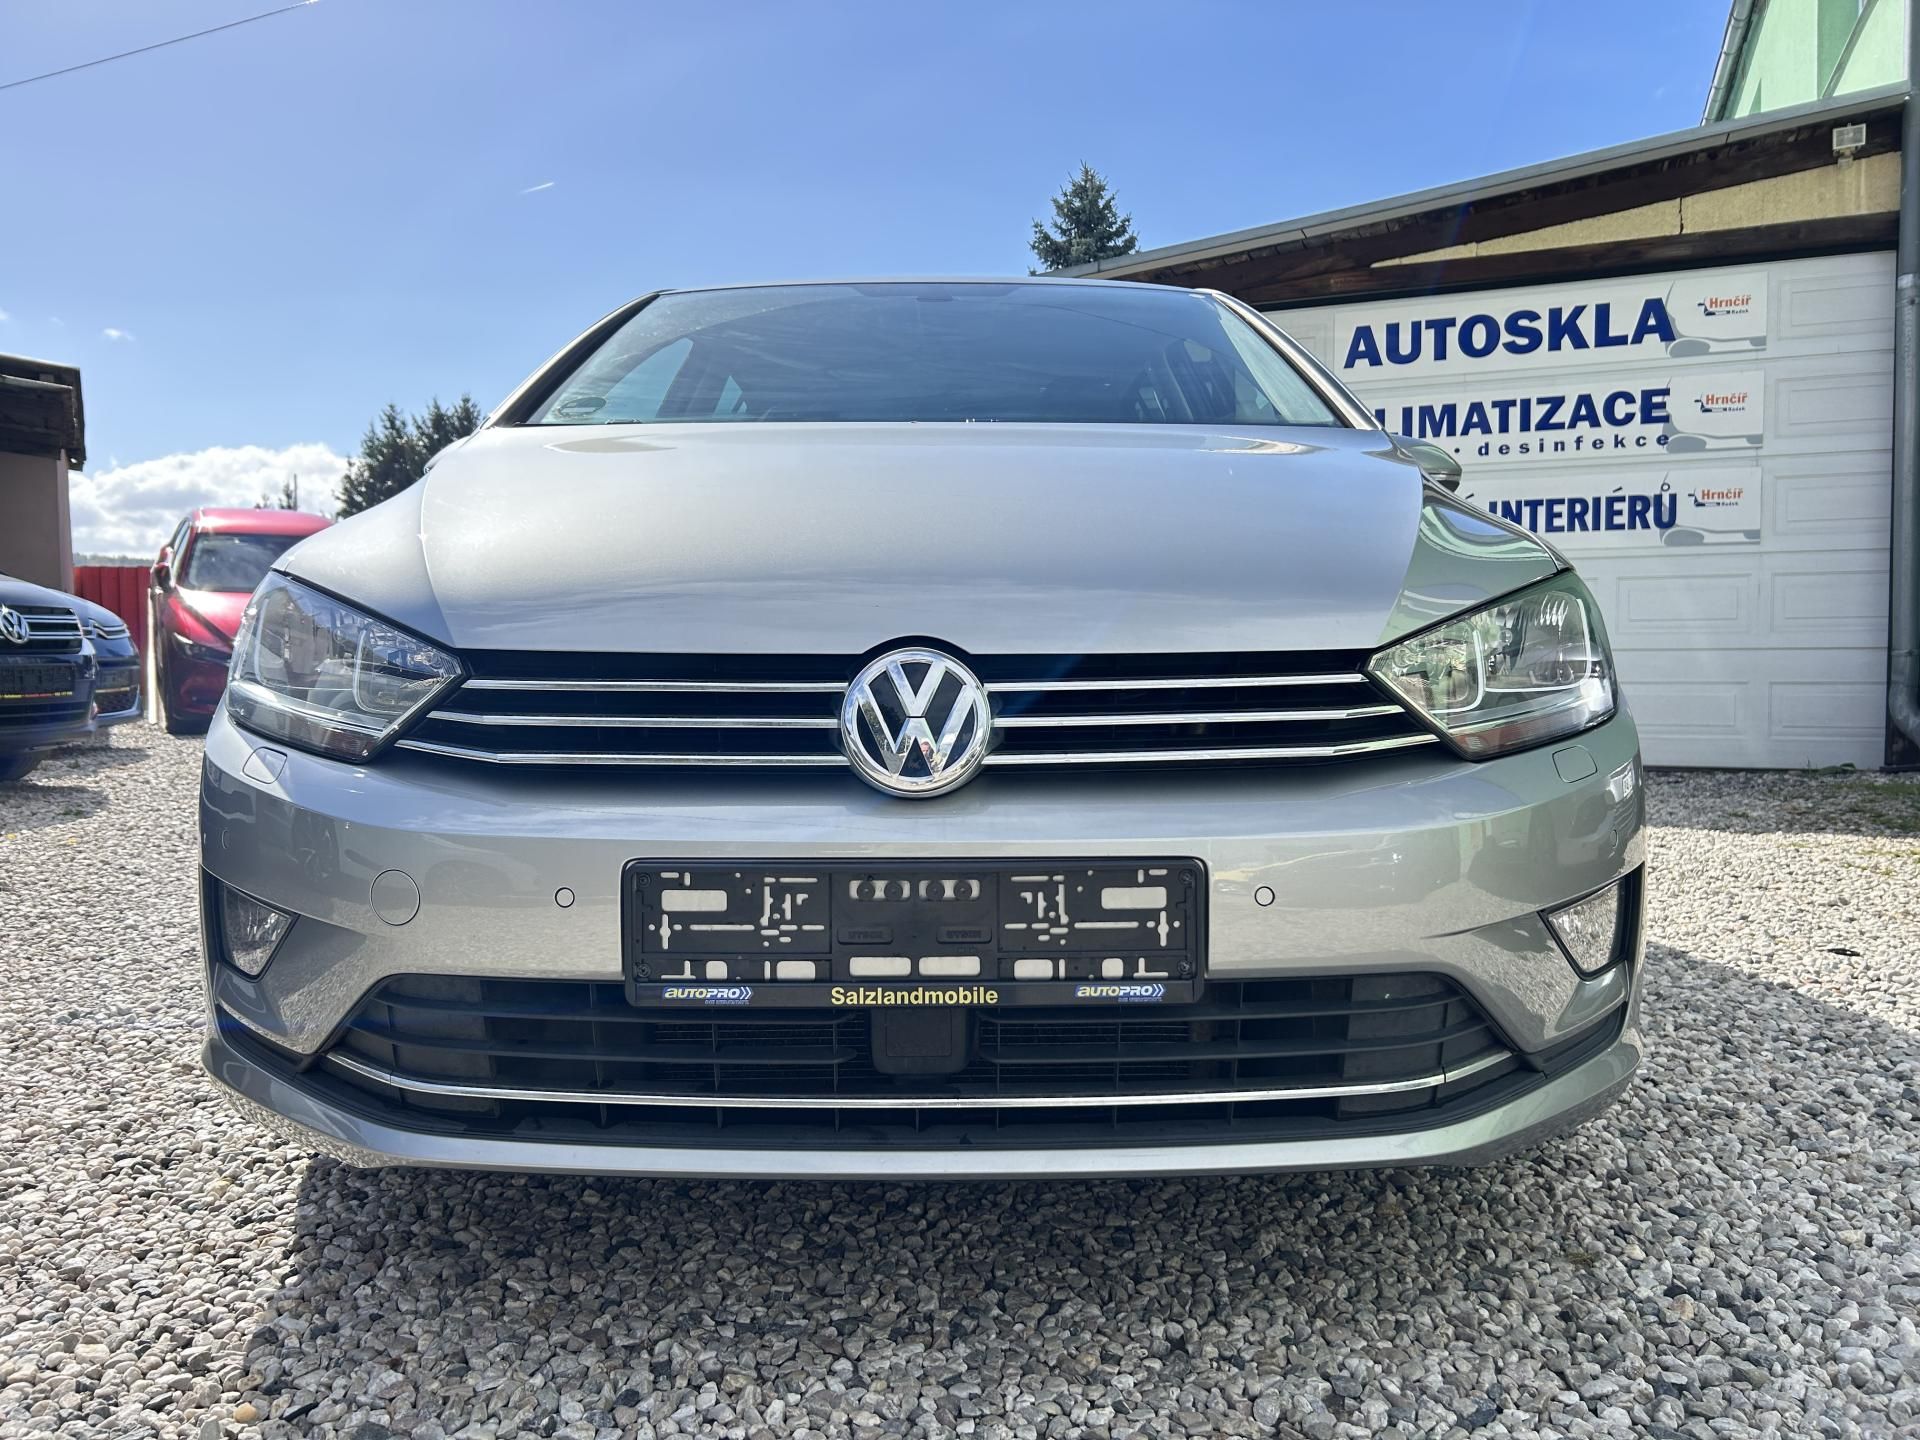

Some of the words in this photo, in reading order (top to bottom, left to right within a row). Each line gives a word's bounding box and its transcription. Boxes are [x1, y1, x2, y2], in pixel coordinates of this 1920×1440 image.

[1344, 297, 1676, 369] AUTOSKLA
[1477, 433, 1670, 457] desinfekce
[851, 655, 980, 782] VW
[831, 986, 999, 1005] Salzlandmobile
